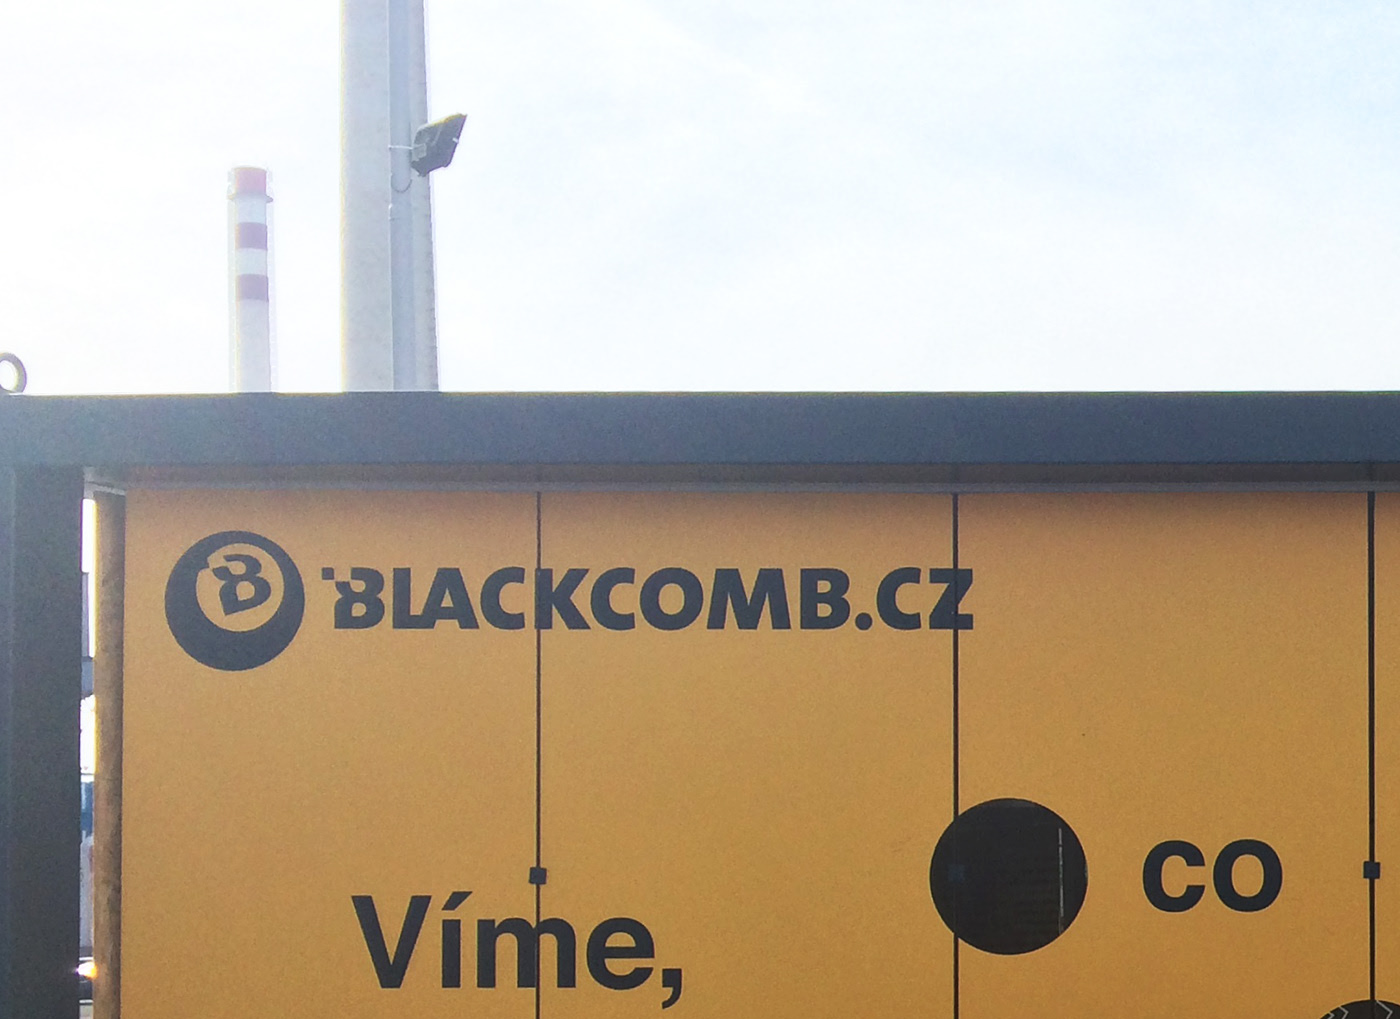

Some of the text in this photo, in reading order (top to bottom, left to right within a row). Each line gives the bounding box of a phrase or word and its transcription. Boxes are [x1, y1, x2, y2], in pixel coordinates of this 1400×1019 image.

[321, 566, 974, 632] BLACKCOMB.CZ
[1143, 838, 1282, 913] co
[351, 891, 684, 1010] Víme,
